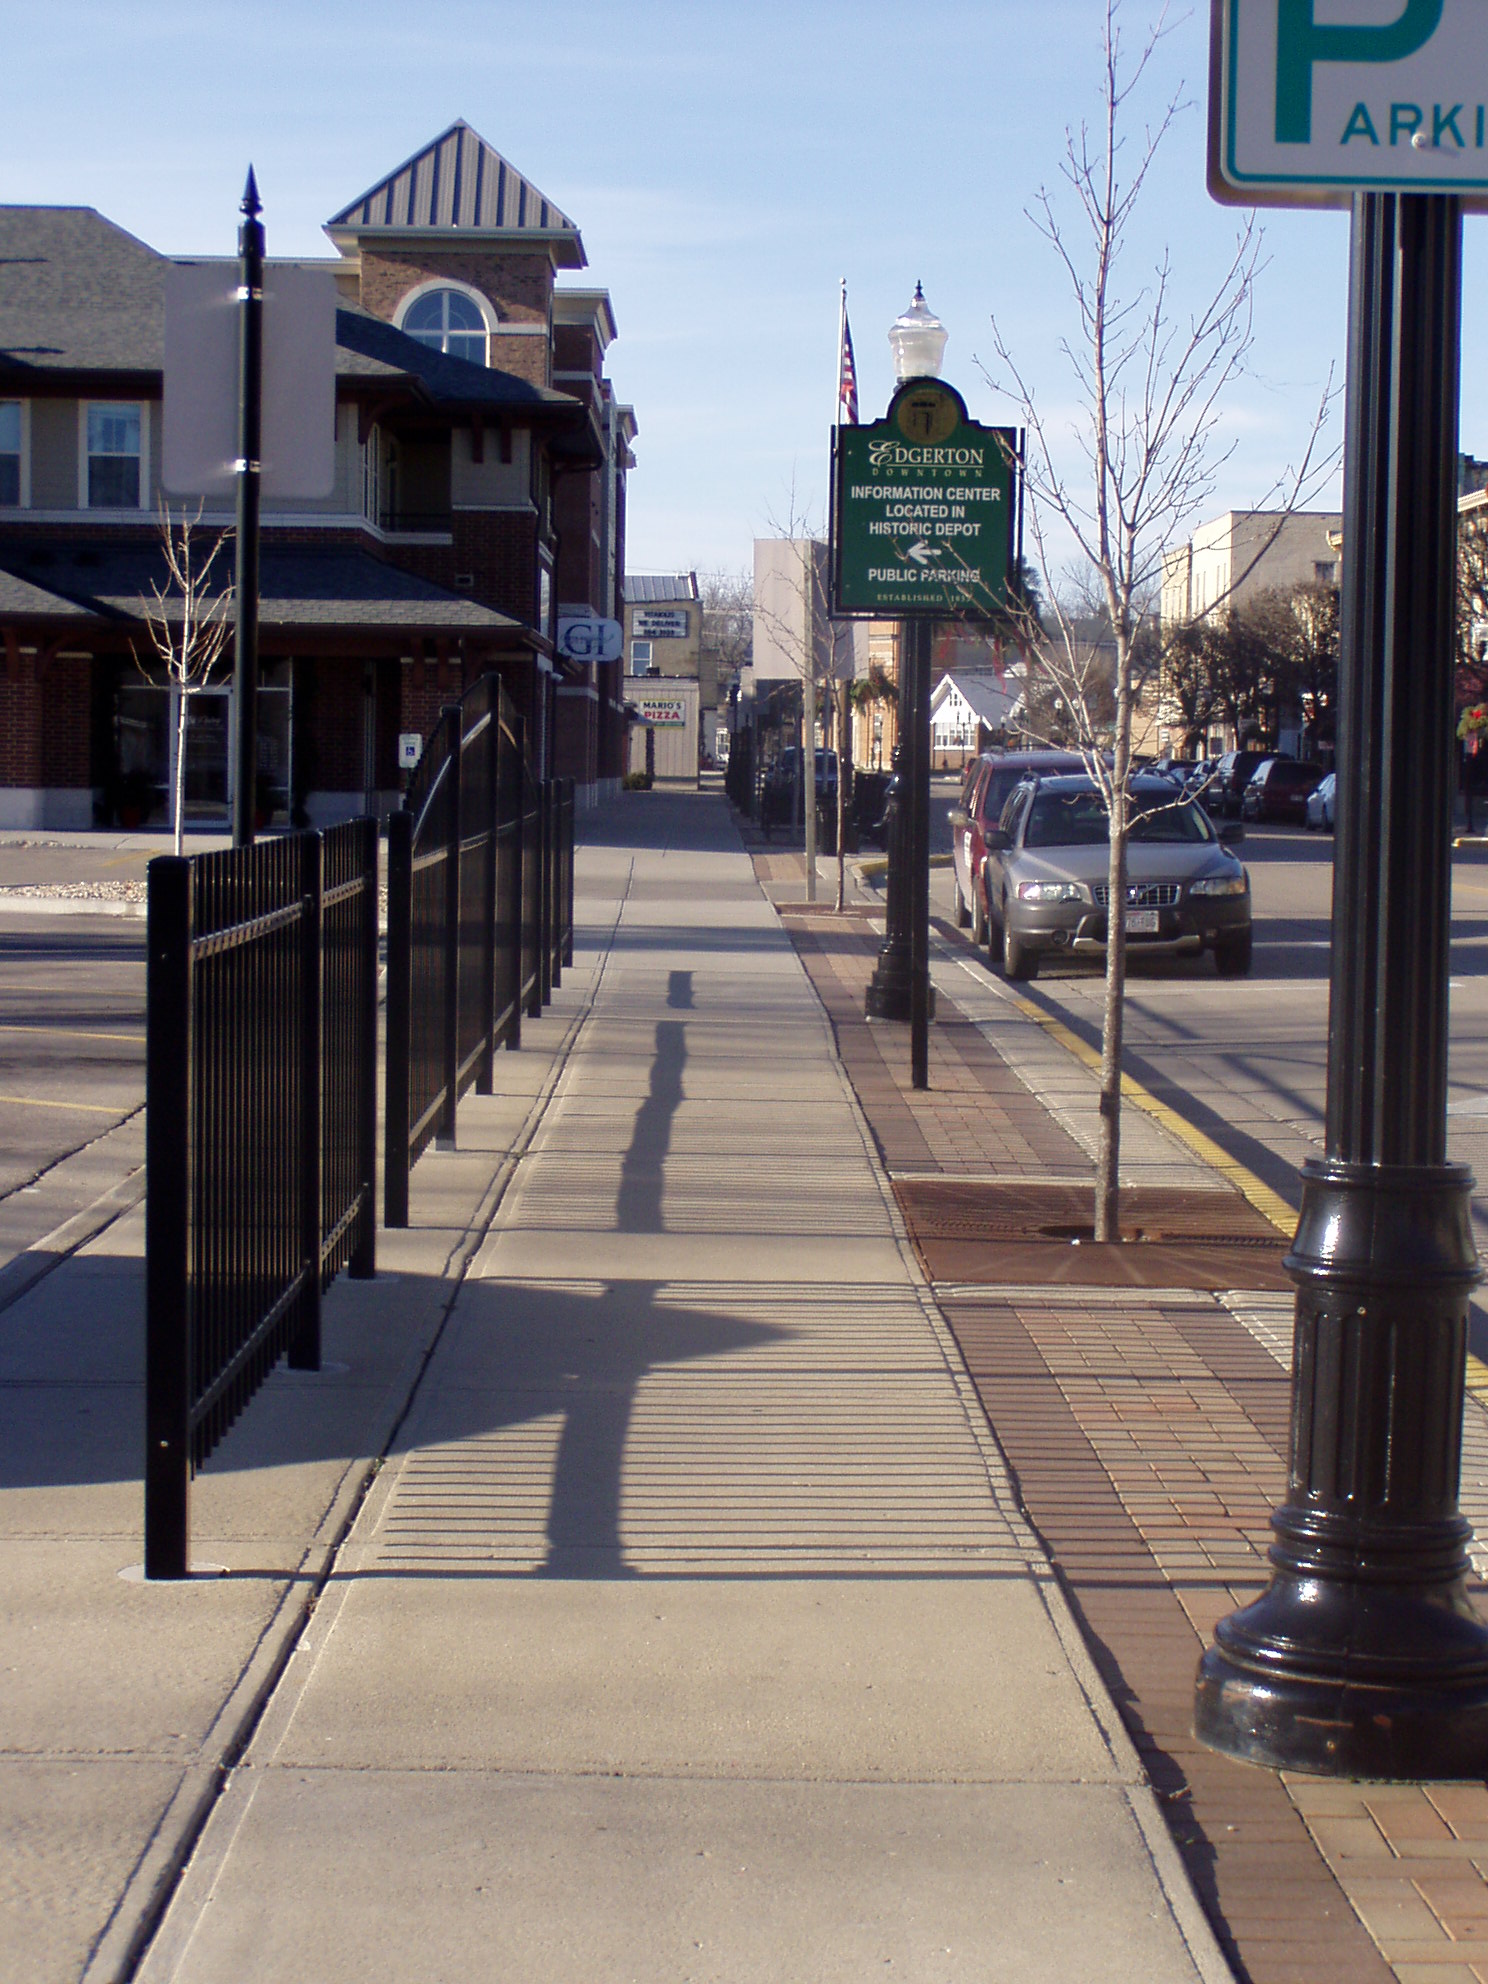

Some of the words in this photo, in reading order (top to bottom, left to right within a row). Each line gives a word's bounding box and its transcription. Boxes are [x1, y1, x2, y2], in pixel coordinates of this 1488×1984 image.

[869, 441, 984, 465] EDGERTON
[872, 468, 983, 477] DOWNTOWN
[851, 485, 946, 500] INFORMATION
[947, 487, 1001, 501] CENTER
[886, 505, 949, 518] LOCATED
[952, 505, 965, 518] IN
[869, 522, 932, 536] HISTORIC
[936, 523, 981, 536] DEPOT
[868, 568, 917, 581] PUBLIC
[920, 569, 981, 582] PARKING
[877, 594, 943, 602] ESTABLISHED
[564, 624, 606, 655] GI
[644, 711, 680, 719] PIZZA
